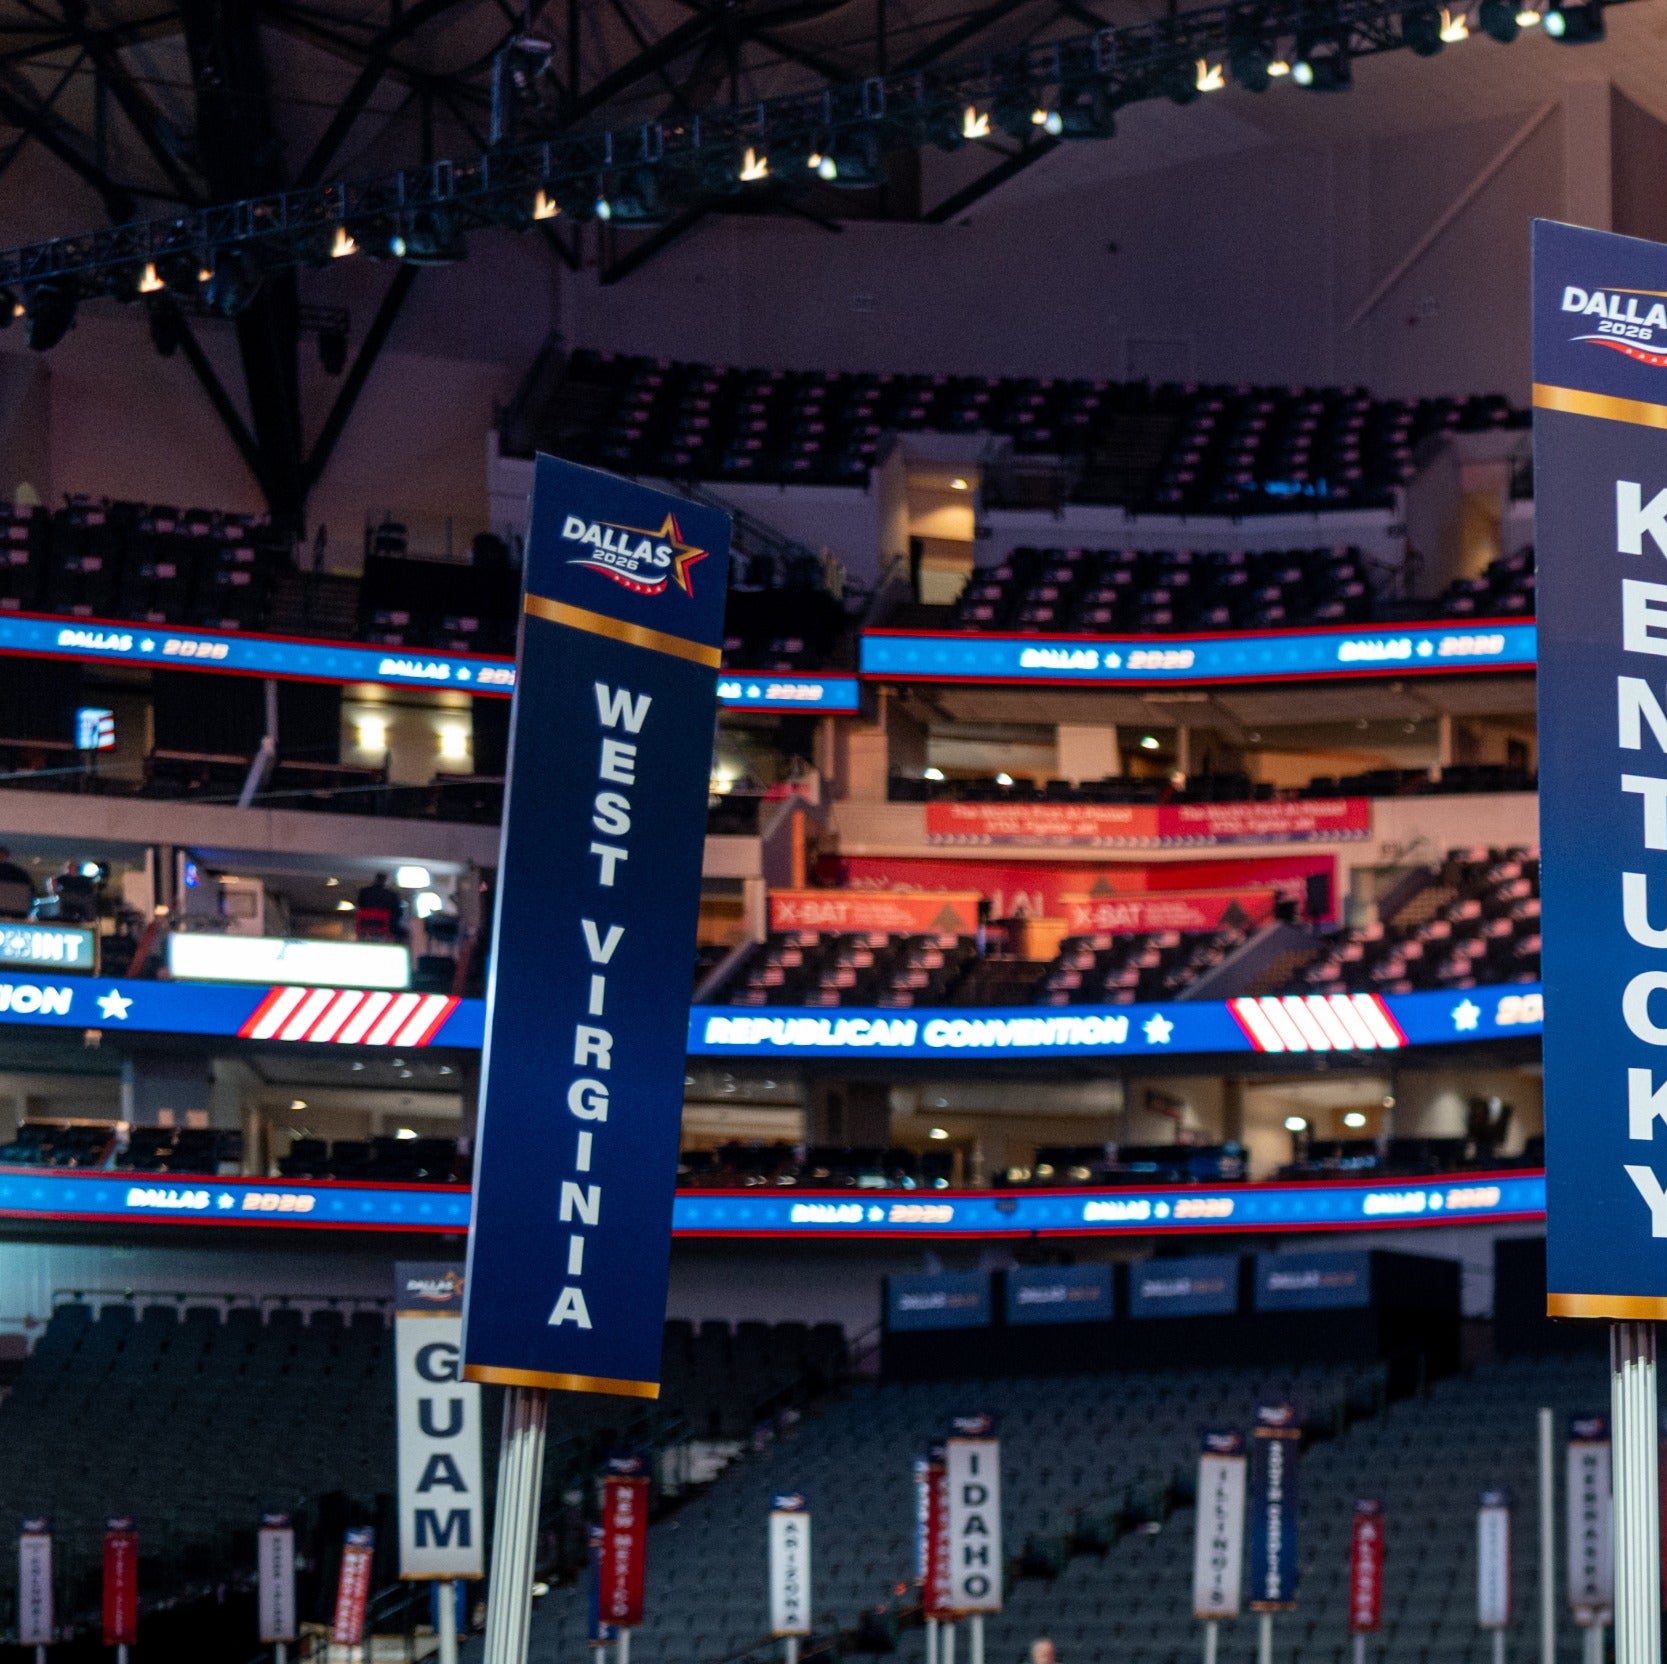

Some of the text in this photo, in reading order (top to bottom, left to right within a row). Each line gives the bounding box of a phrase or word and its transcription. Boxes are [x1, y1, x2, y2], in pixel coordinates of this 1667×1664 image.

[1597, 320, 1653, 340] 2026
[562, 515, 673, 568] DALLAS
[593, 550, 639, 570] 2026
[58, 630, 132, 651] DALLAS
[380, 660, 450, 680] DALLAS
[548, 682, 652, 1330] WEST VIRGINIA
[705, 1015, 1129, 1047] REPUBLICAN CONVENTION
[128, 1188, 208, 1209] DALLAS
[414, 1342, 472, 1548] GUAM
[611, 1486, 634, 1617] NEW MEXICO
[962, 1453, 991, 1598] IDAHO
[1210, 1467, 1228, 1606] ILLINOIS
[785, 1521, 799, 1625] ARIZONA
